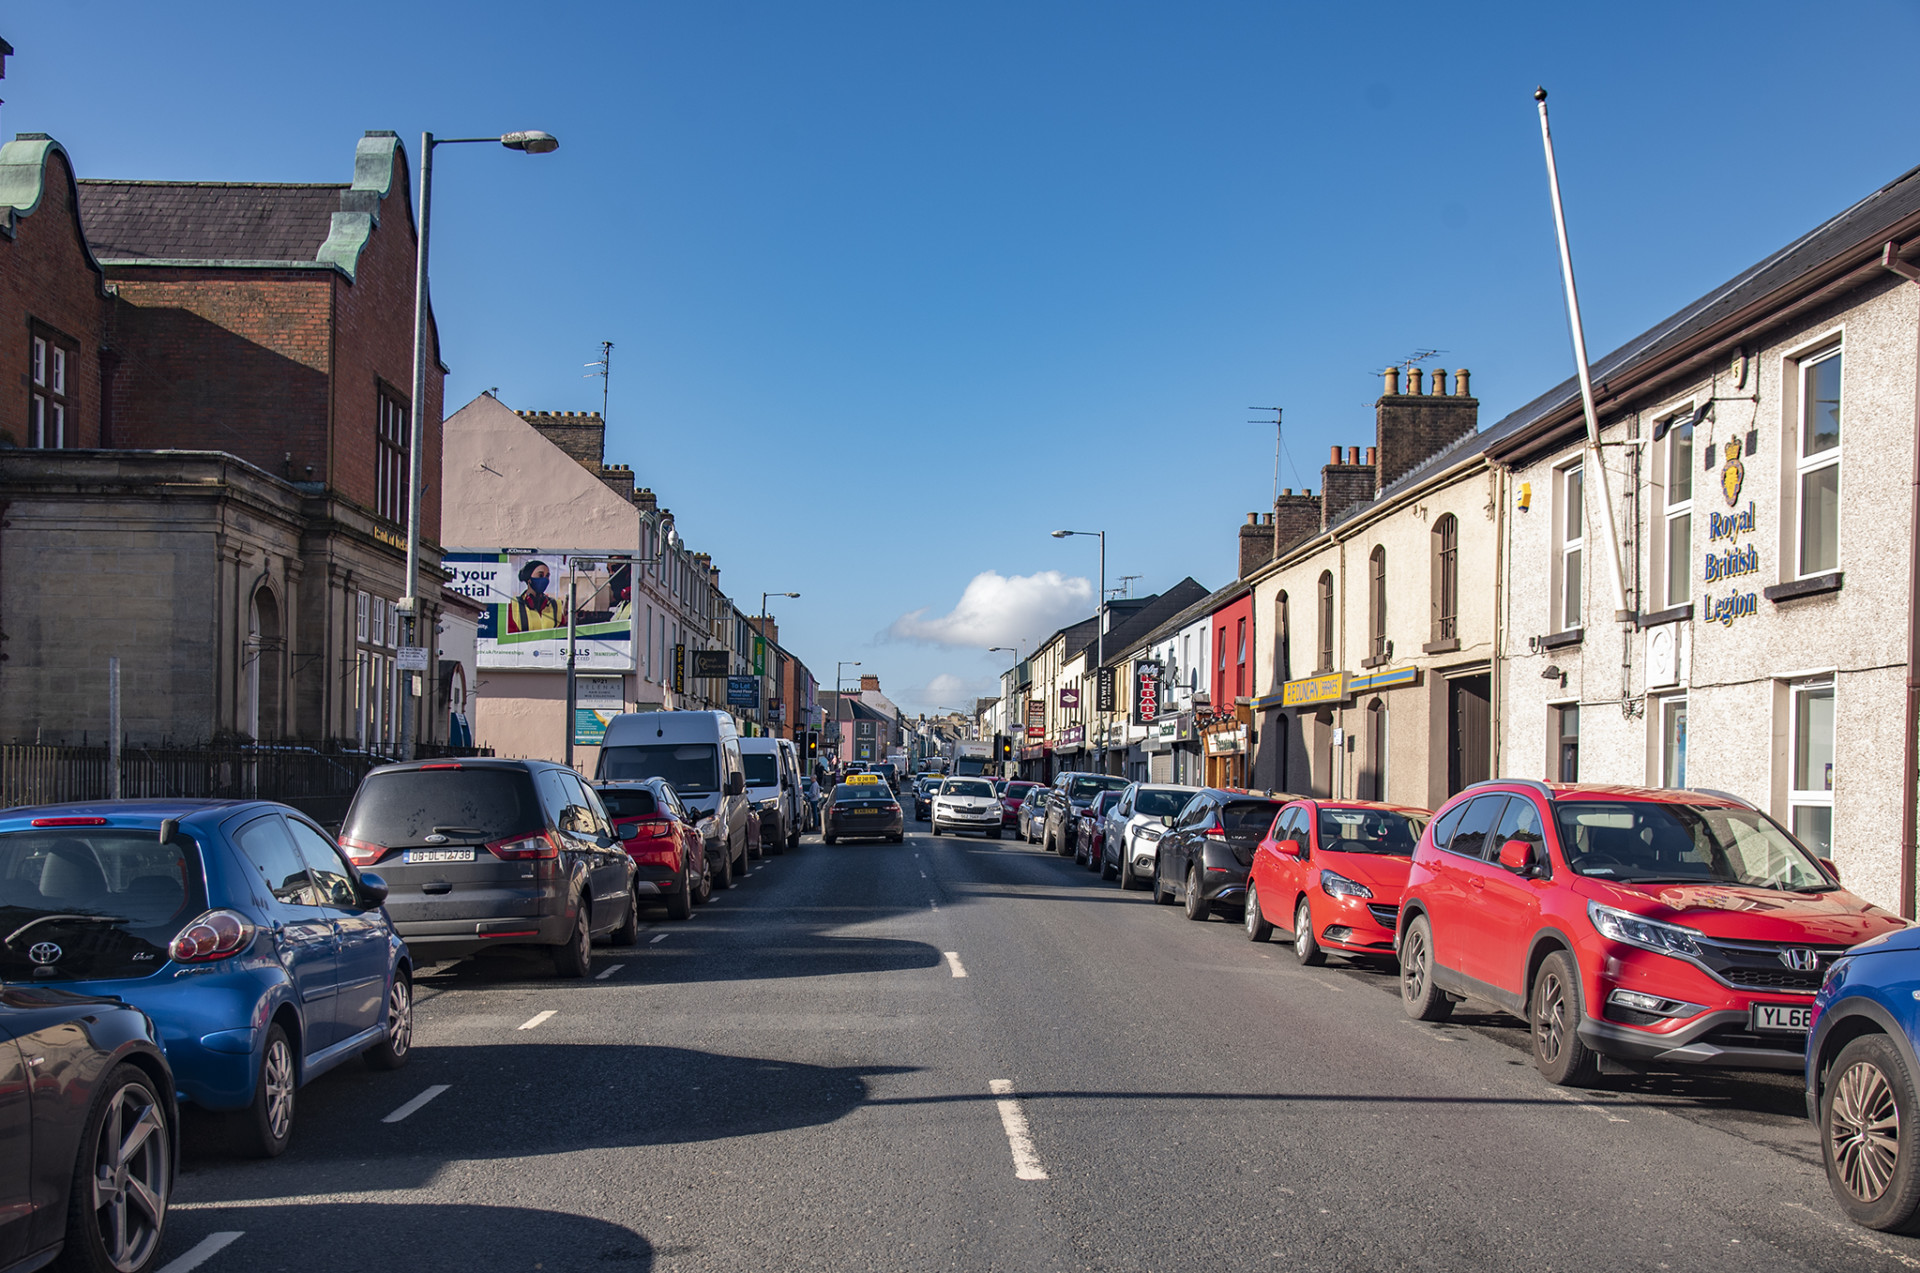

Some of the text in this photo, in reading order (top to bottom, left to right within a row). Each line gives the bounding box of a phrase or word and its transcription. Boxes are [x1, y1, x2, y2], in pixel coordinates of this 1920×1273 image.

[374, 525, 388, 543] Bank
[1709, 501, 1755, 544] Royal
[461, 571, 497, 583] your
[1704, 543, 1758, 583] British
[1704, 588, 1757, 627] Legion
[1139, 674, 1157, 722] KEBABS
[1296, 680, 1319, 701] DUNCAN
[1764, 1007, 1812, 1027] YL66
